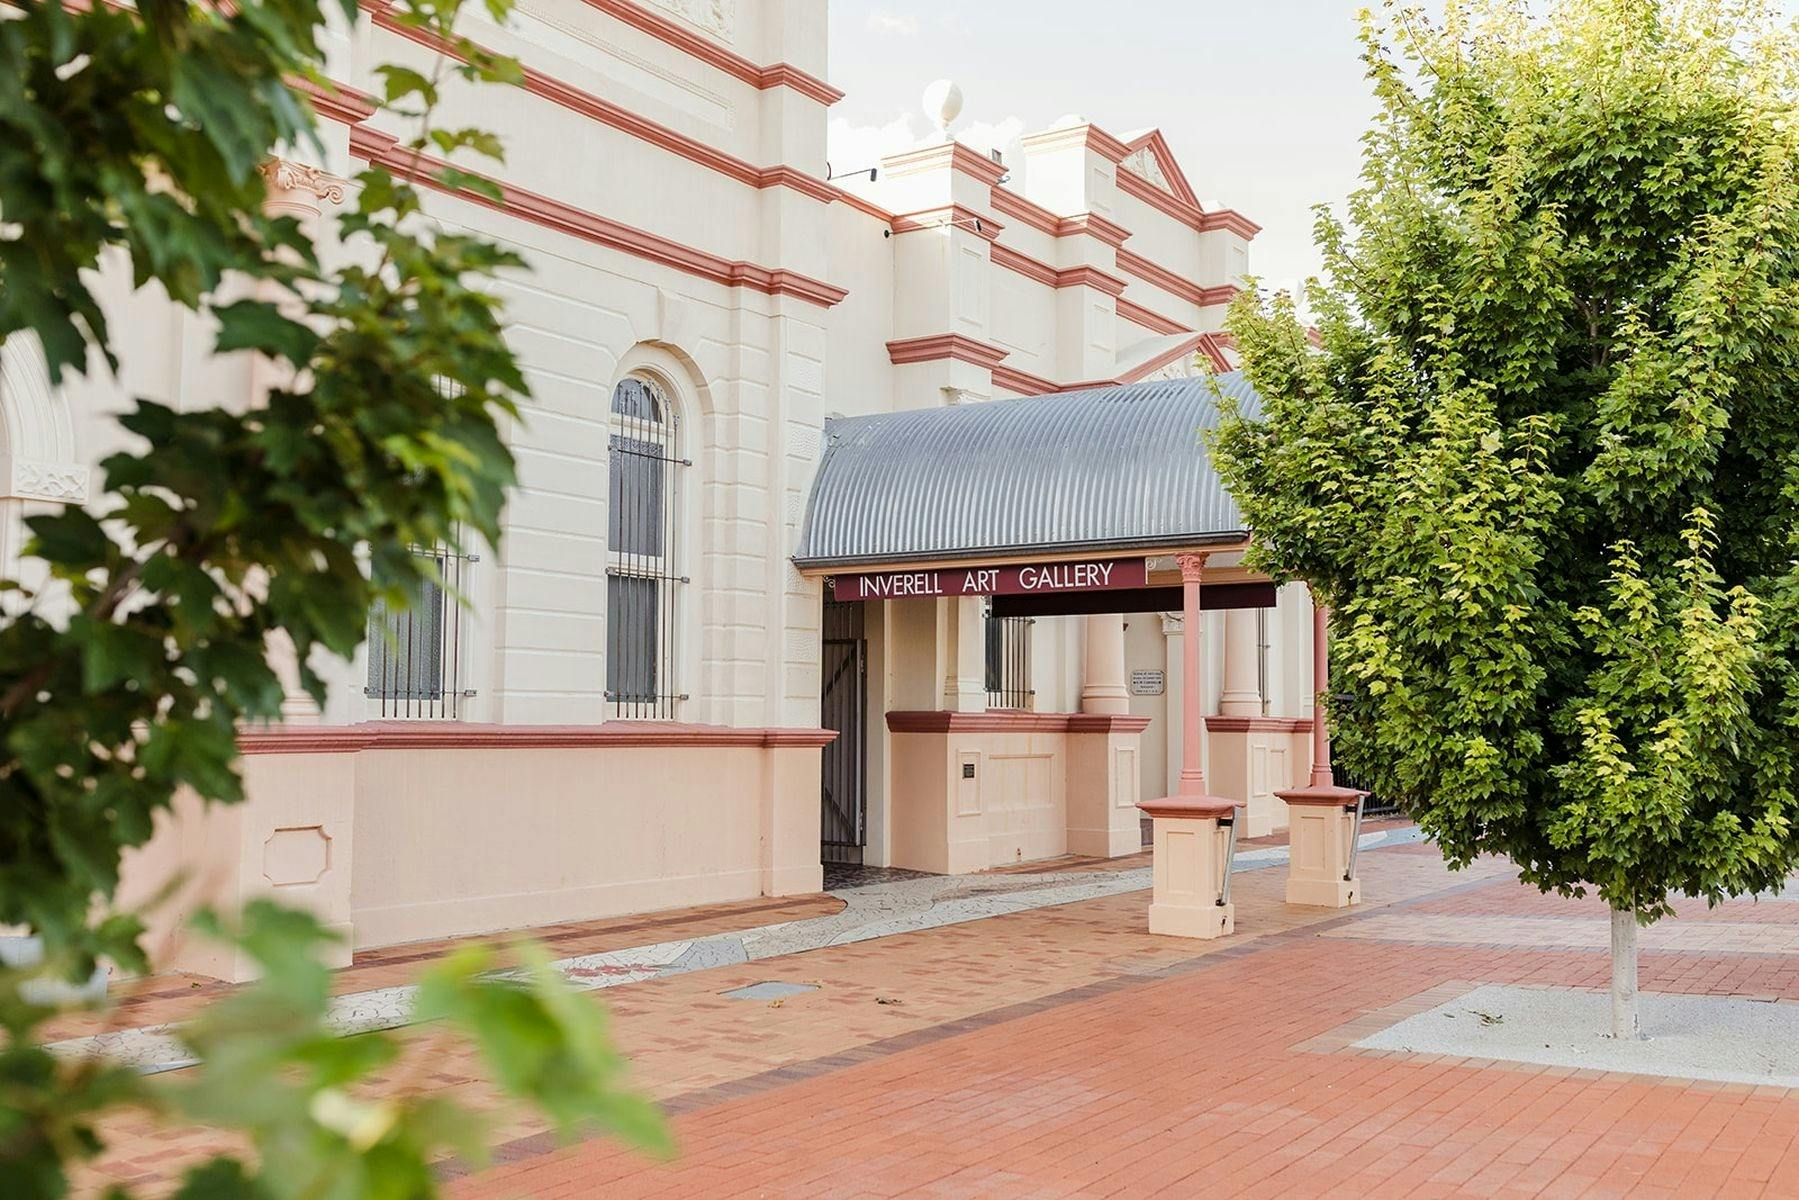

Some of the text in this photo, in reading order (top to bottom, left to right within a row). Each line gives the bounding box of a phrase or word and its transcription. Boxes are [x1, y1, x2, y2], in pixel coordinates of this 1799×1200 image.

[859, 562, 1114, 597] INVERELL ART GALLERY
